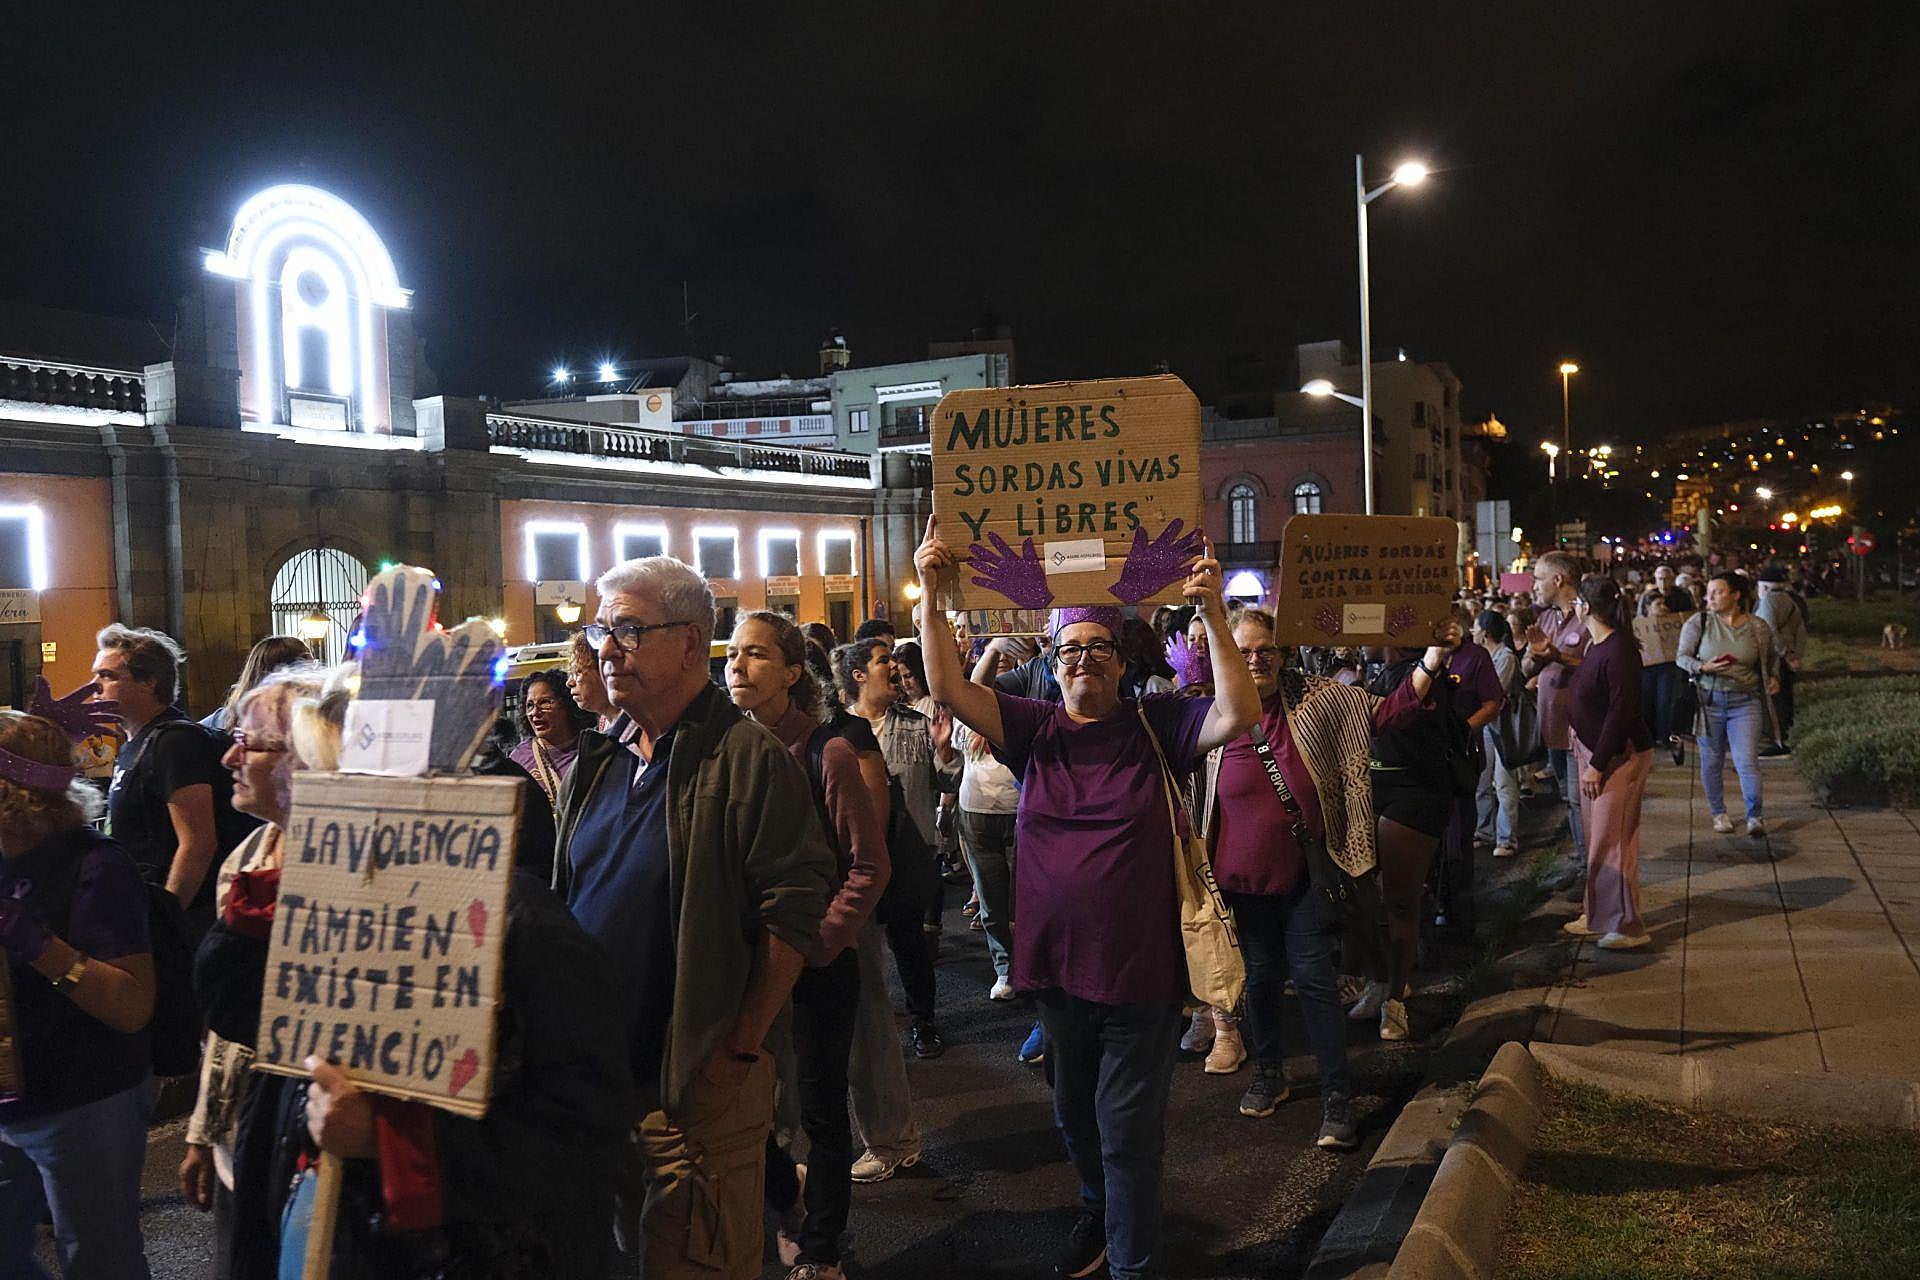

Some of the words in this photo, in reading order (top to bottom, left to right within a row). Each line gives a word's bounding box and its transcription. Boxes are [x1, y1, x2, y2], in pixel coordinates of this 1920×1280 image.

[953, 461, 1084, 497] SORDAS
[958, 508, 991, 541] Y
[276, 957, 416, 1012] EXISTE
[432, 965, 480, 1009] EN
